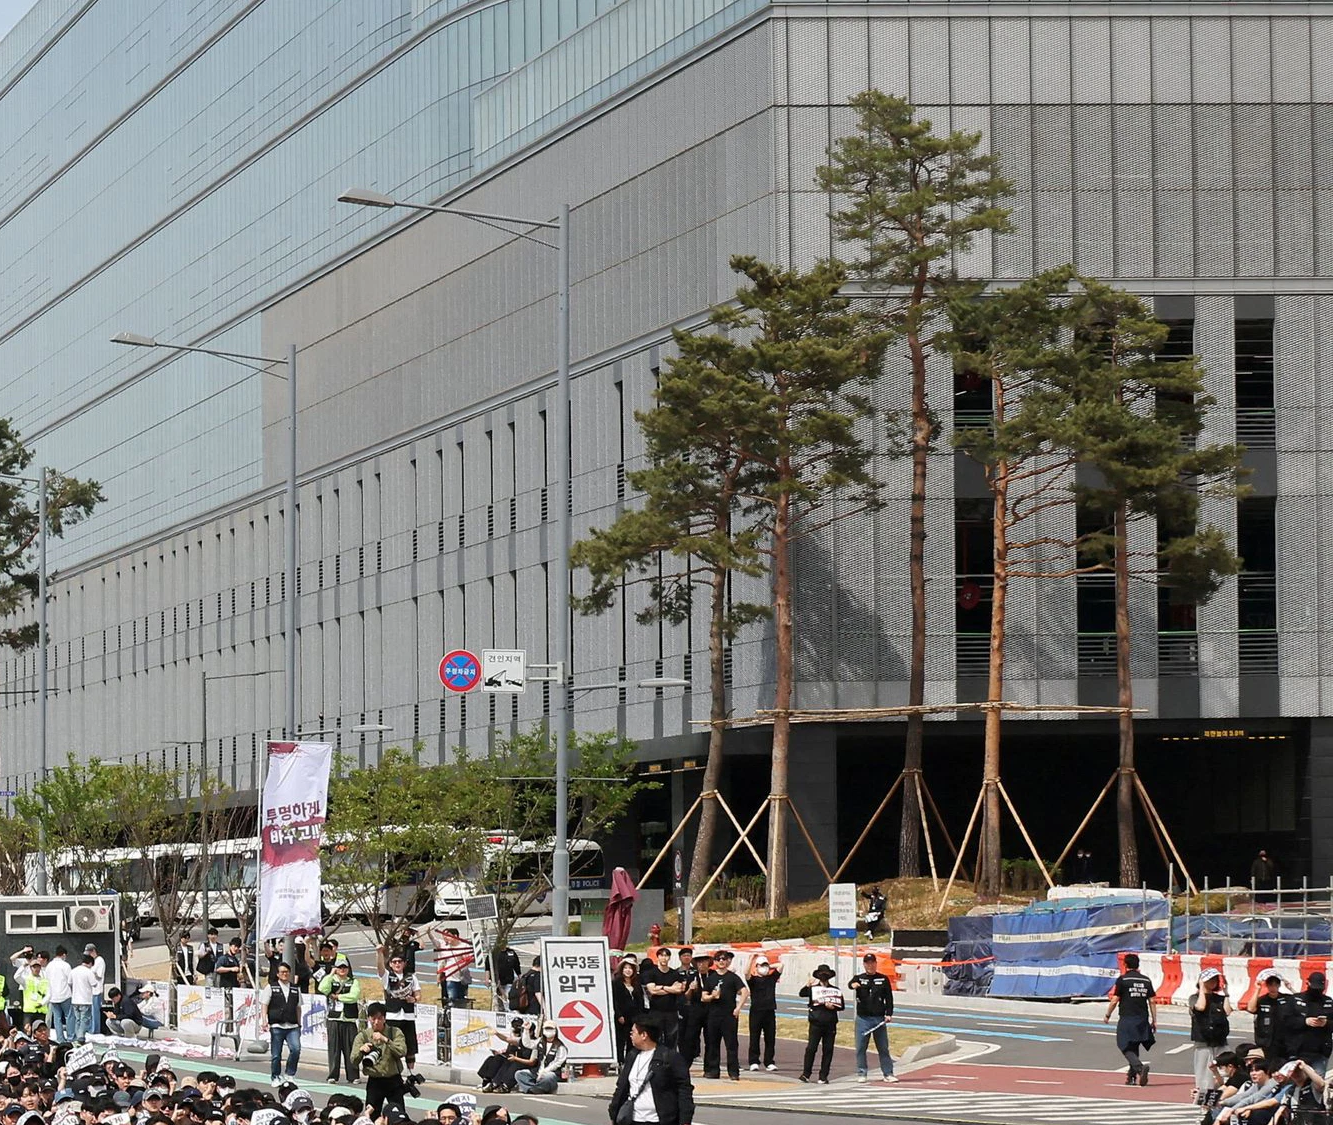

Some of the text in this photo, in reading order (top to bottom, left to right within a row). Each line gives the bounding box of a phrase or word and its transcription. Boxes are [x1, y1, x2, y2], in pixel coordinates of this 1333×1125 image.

[488, 655, 521, 663] 견인지역
[266, 801, 321, 826] 투명하게
[582, 879, 600, 887] POLICE
[551, 955, 600, 970] 사무3동
[558, 975, 596, 993] 입구
